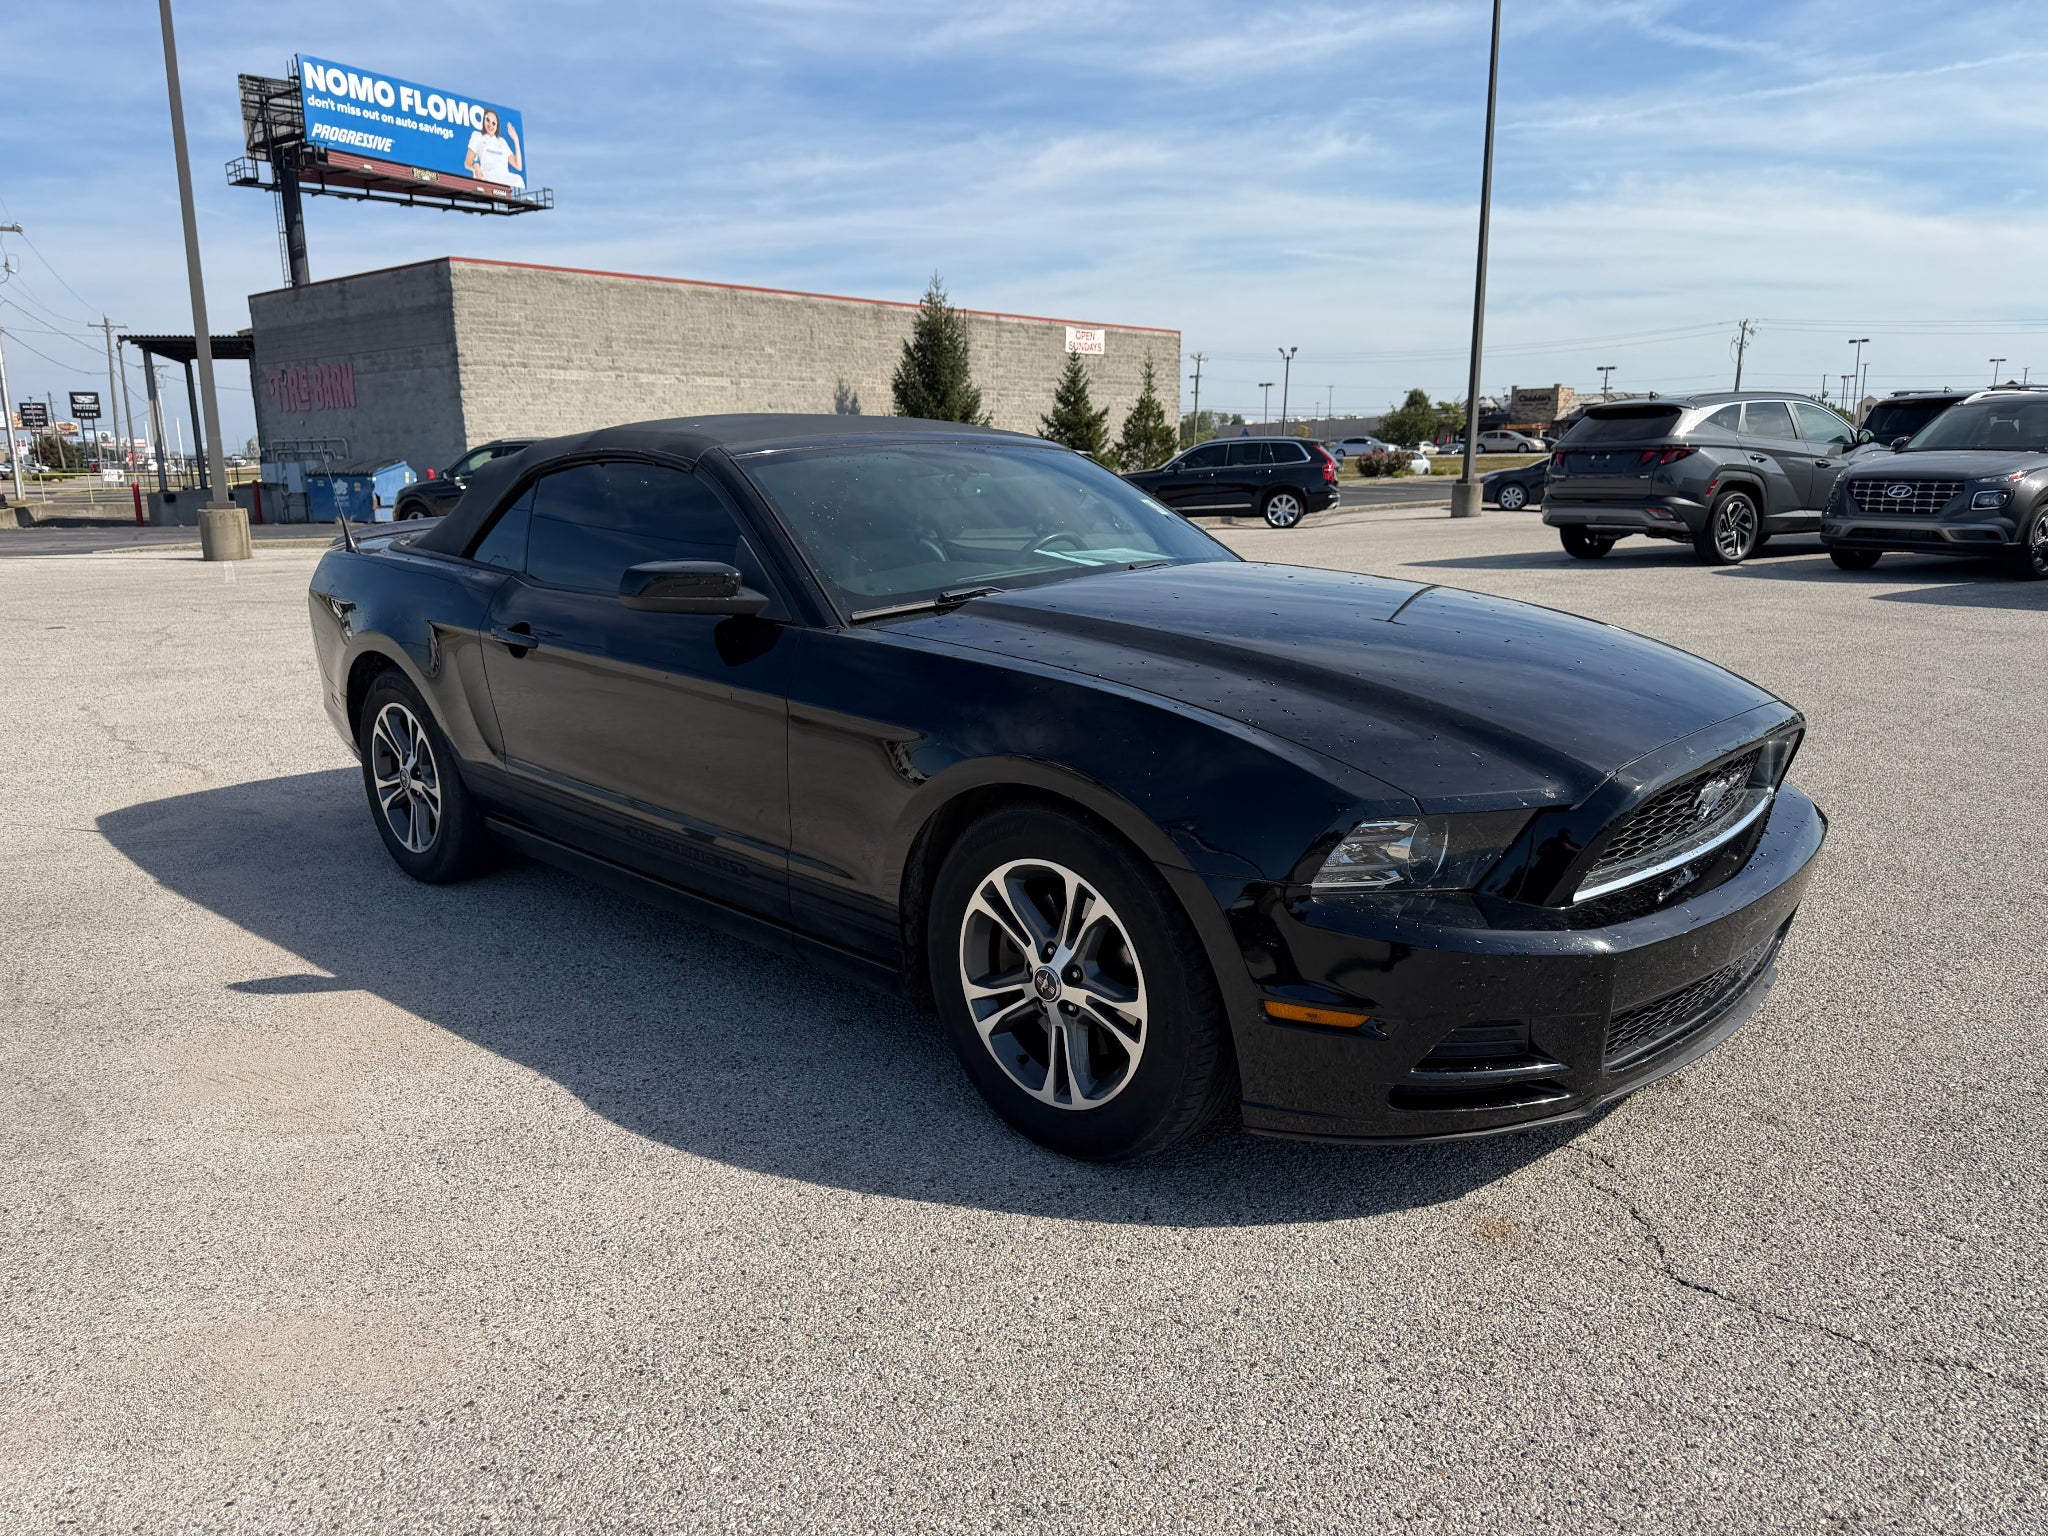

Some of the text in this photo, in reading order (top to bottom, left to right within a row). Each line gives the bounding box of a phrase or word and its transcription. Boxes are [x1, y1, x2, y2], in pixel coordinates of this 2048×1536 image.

[303, 61, 484, 130] NOMO FLOMO
[307, 94, 454, 139] don't miss out on auto savings
[311, 122, 393, 153] PROGRESSIVE
[1068, 330, 1102, 352] OPEN SUNDAYS
[313, 361, 357, 411] BARN
